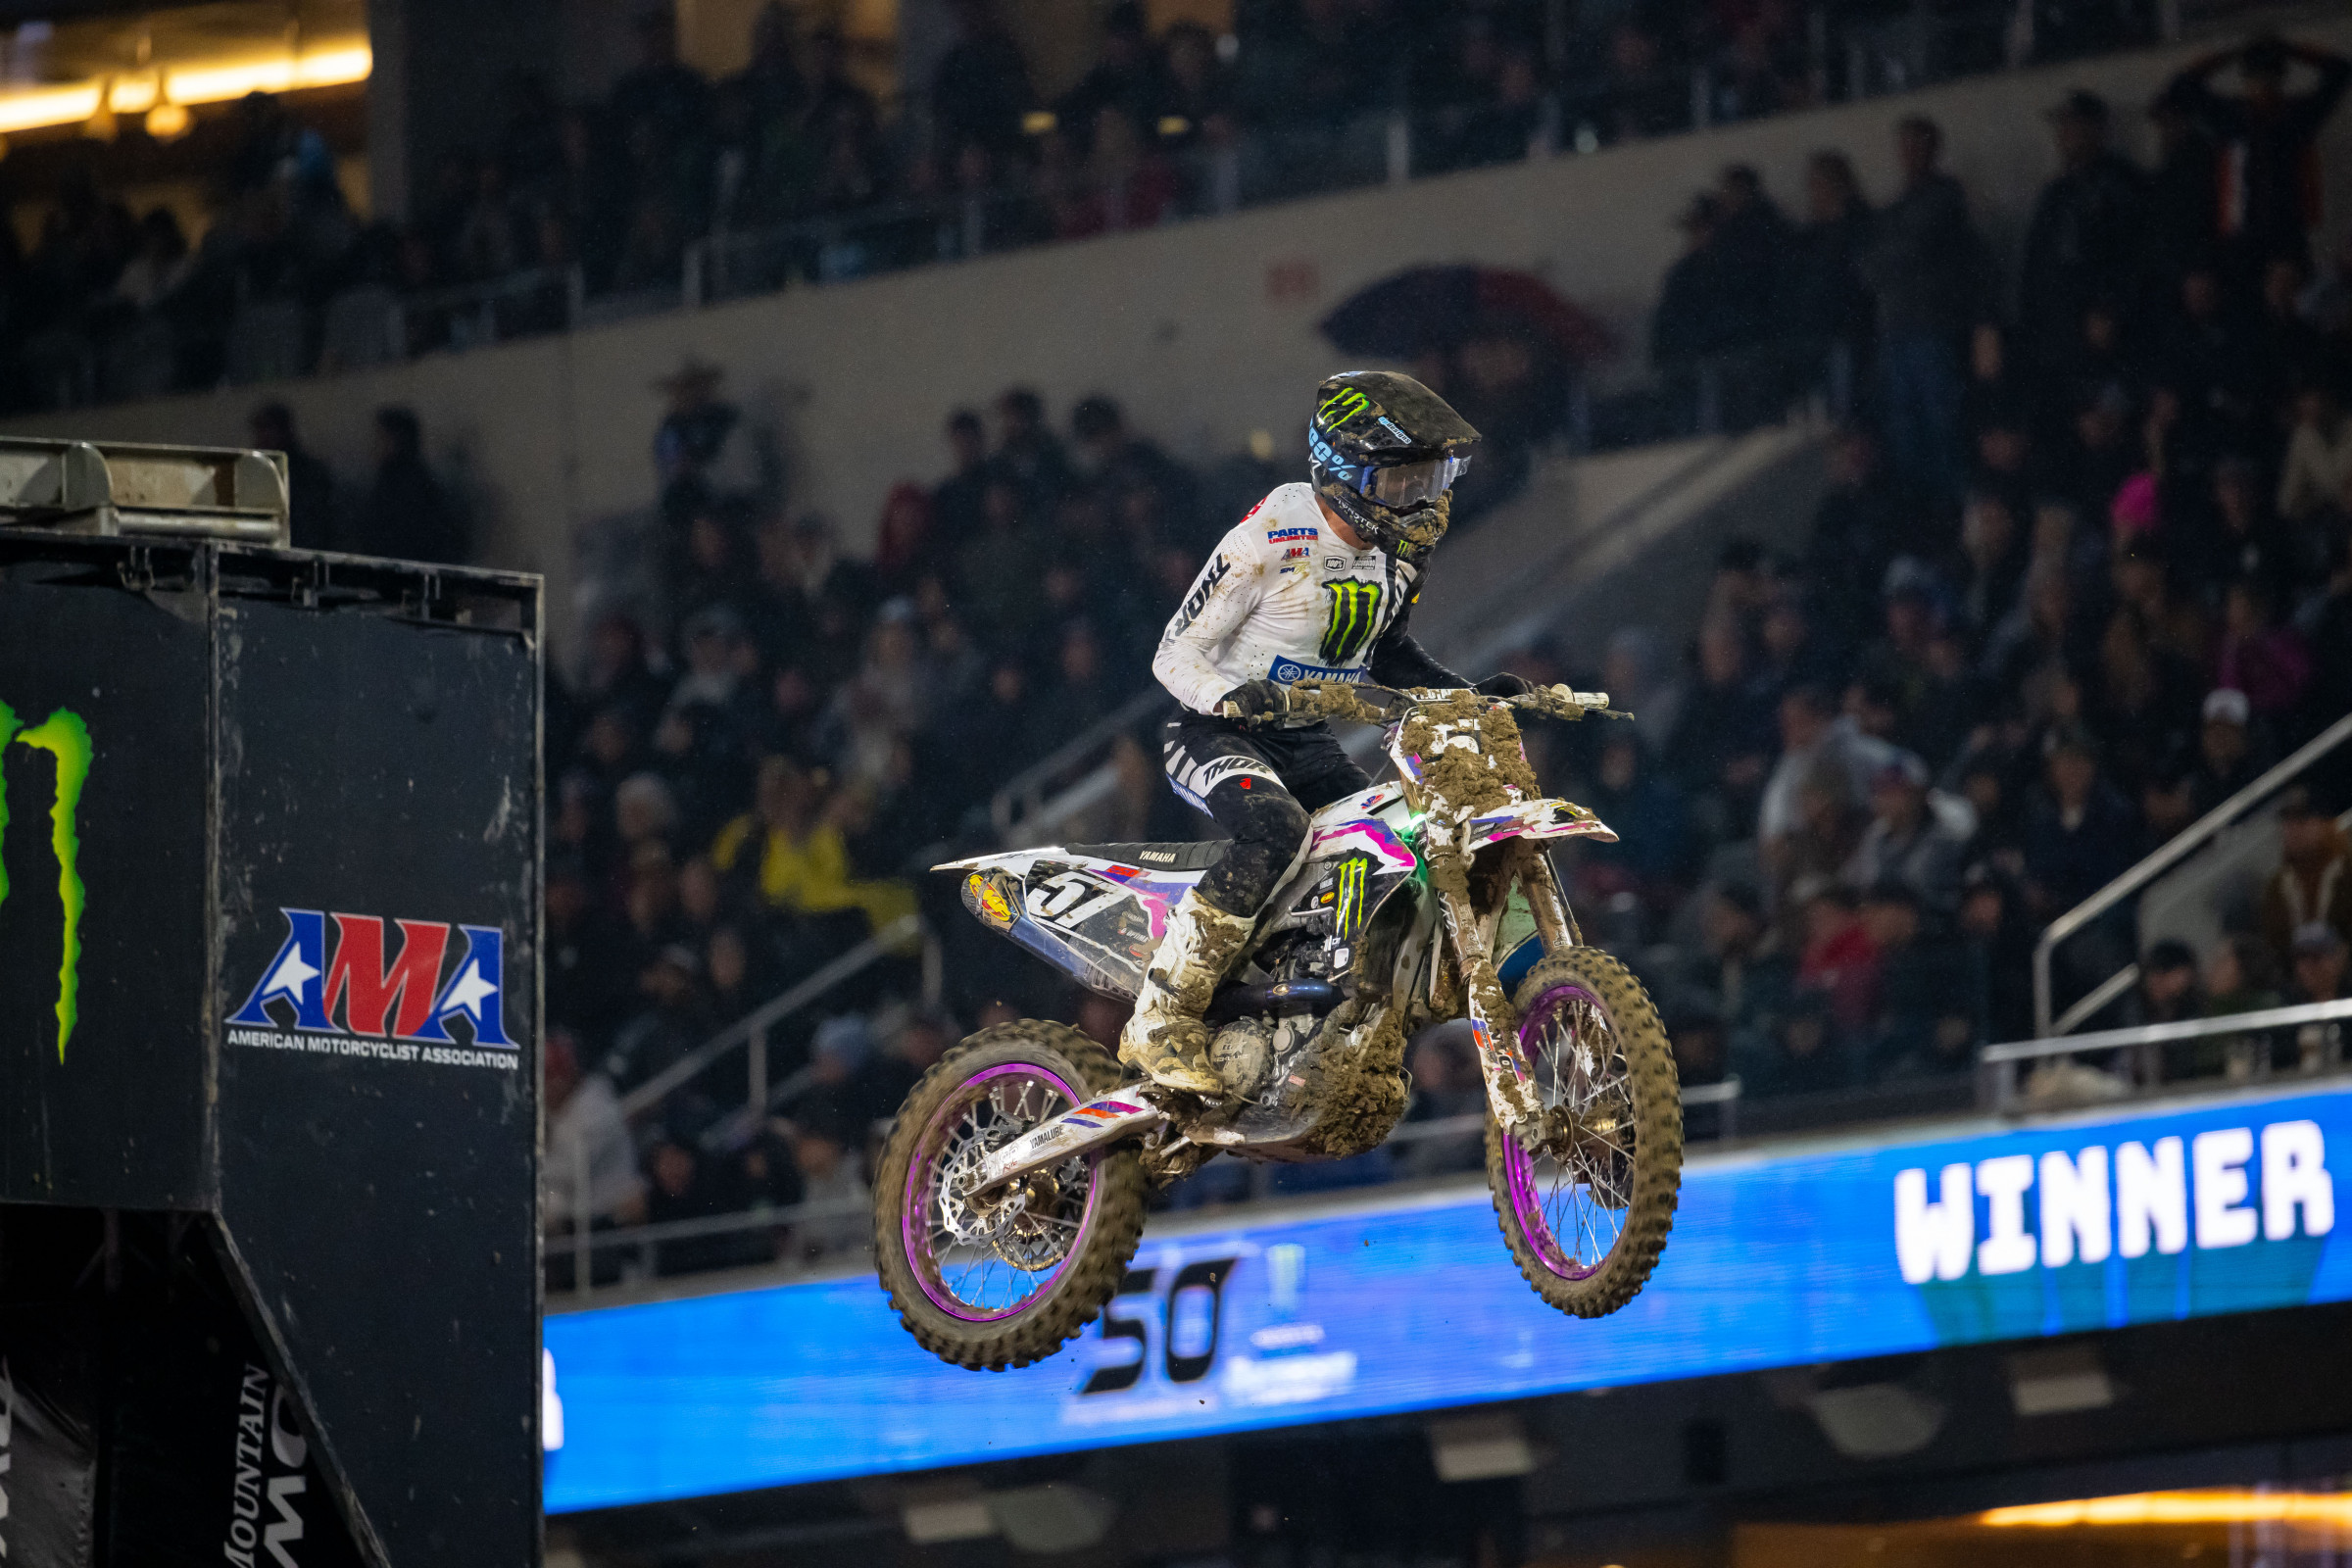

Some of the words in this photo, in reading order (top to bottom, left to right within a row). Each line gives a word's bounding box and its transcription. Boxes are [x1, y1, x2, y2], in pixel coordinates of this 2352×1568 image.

[1267, 527, 1318, 540] PARTS
[1280, 547, 1309, 562] AMA
[1326, 559, 1344, 568] 100%
[1172, 552, 1231, 639] THOR
[1303, 668, 1362, 684] YAMAHA
[1202, 757, 1272, 788] THOR
[1139, 850, 1176, 863] YAMAHA
[224, 906, 520, 1049] AMA
[227, 1029, 306, 1052] AMERICAN
[307, 1034, 420, 1062] MOTORCYCLIST
[421, 1048, 519, 1070] ASSOCIATION
[1029, 1125, 1064, 1150] YAMALUBE
[1894, 1120, 2334, 1285] WINNER
